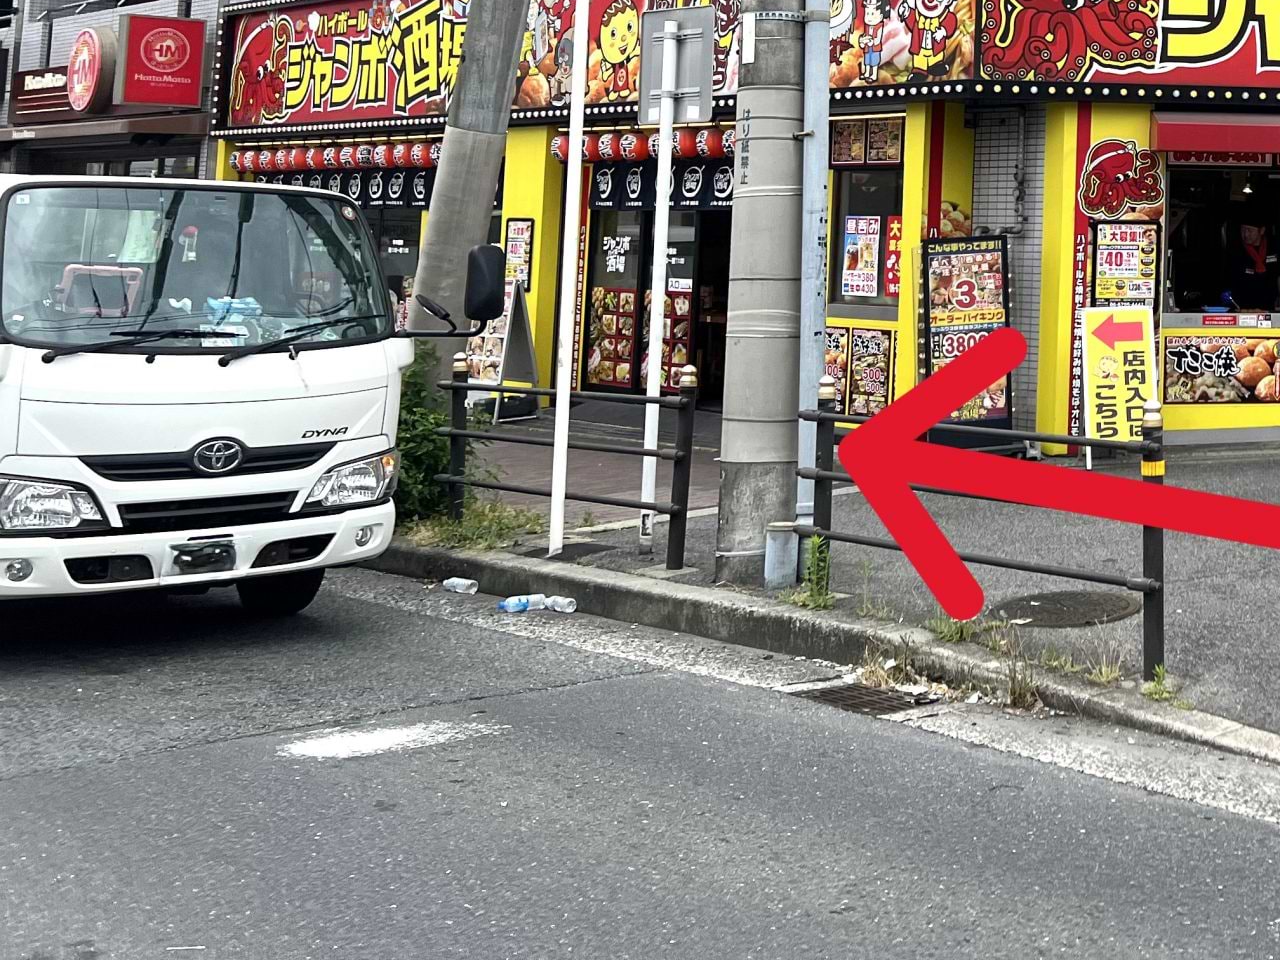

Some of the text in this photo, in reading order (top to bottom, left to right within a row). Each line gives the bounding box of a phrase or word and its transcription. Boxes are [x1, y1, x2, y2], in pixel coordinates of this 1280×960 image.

[317, 8, 369, 37] ハイボール
[606, 255, 626, 273] 酒場
[955, 278, 978, 310] 3
[862, 367, 881, 381] 500
[1167, 346, 1241, 377] たこ焼
[1123, 351, 1147, 437] 店内入口は
[1096, 384, 1118, 439] こちら
[301, 426, 349, 439] DYNA
